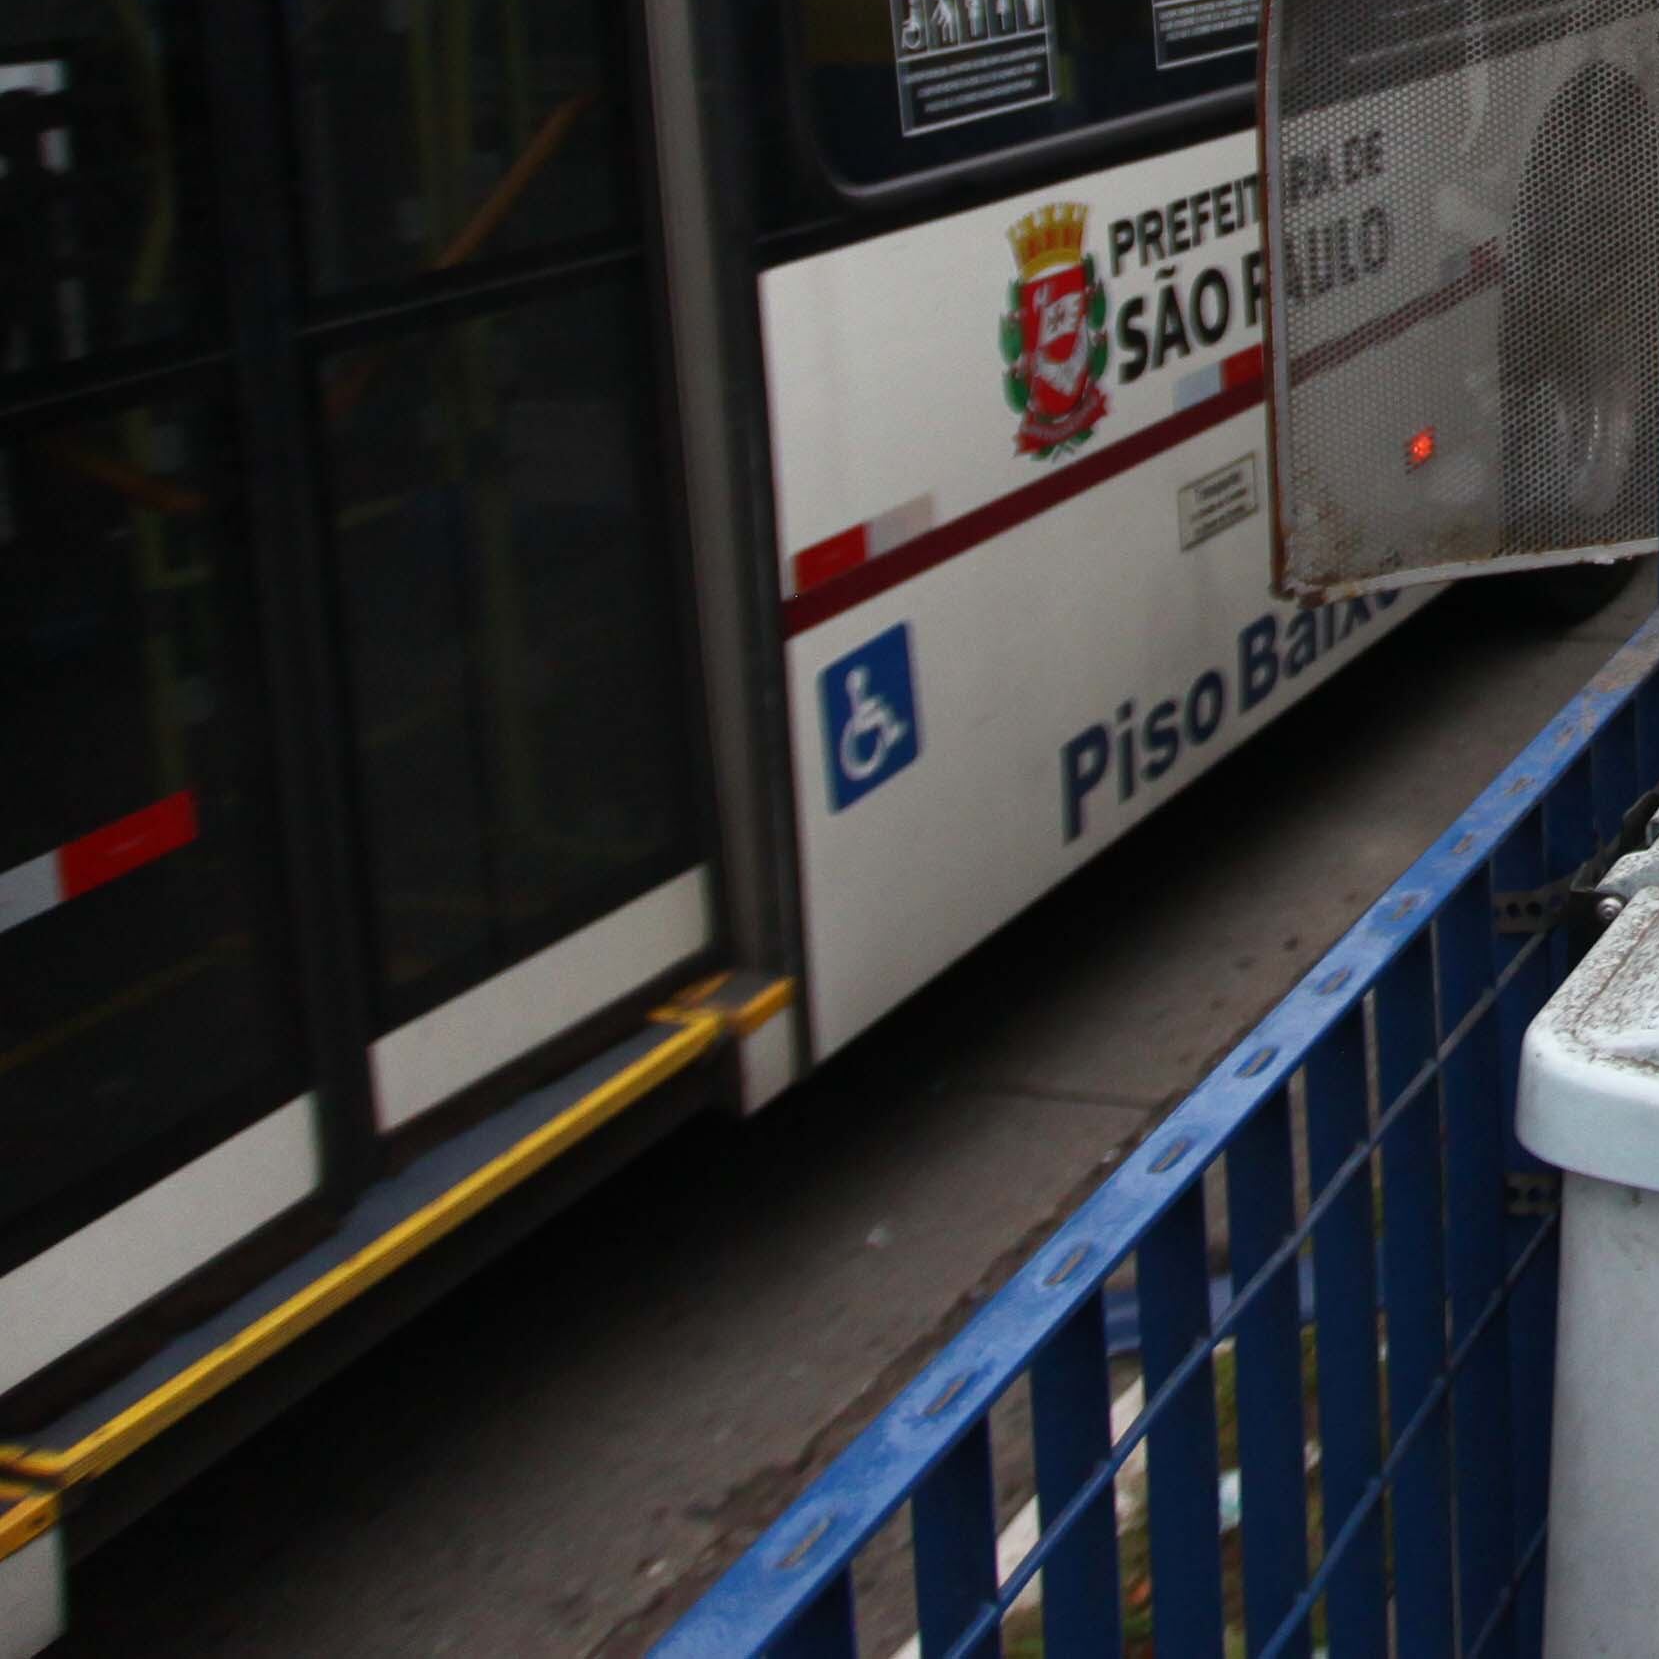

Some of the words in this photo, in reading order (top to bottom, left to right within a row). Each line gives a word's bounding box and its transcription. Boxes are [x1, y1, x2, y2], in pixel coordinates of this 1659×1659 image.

[1108, 147, 1337, 277] PREFEITRA
[1115, 264, 1231, 384] SÃO
[1060, 695, 1226, 844] Piso
